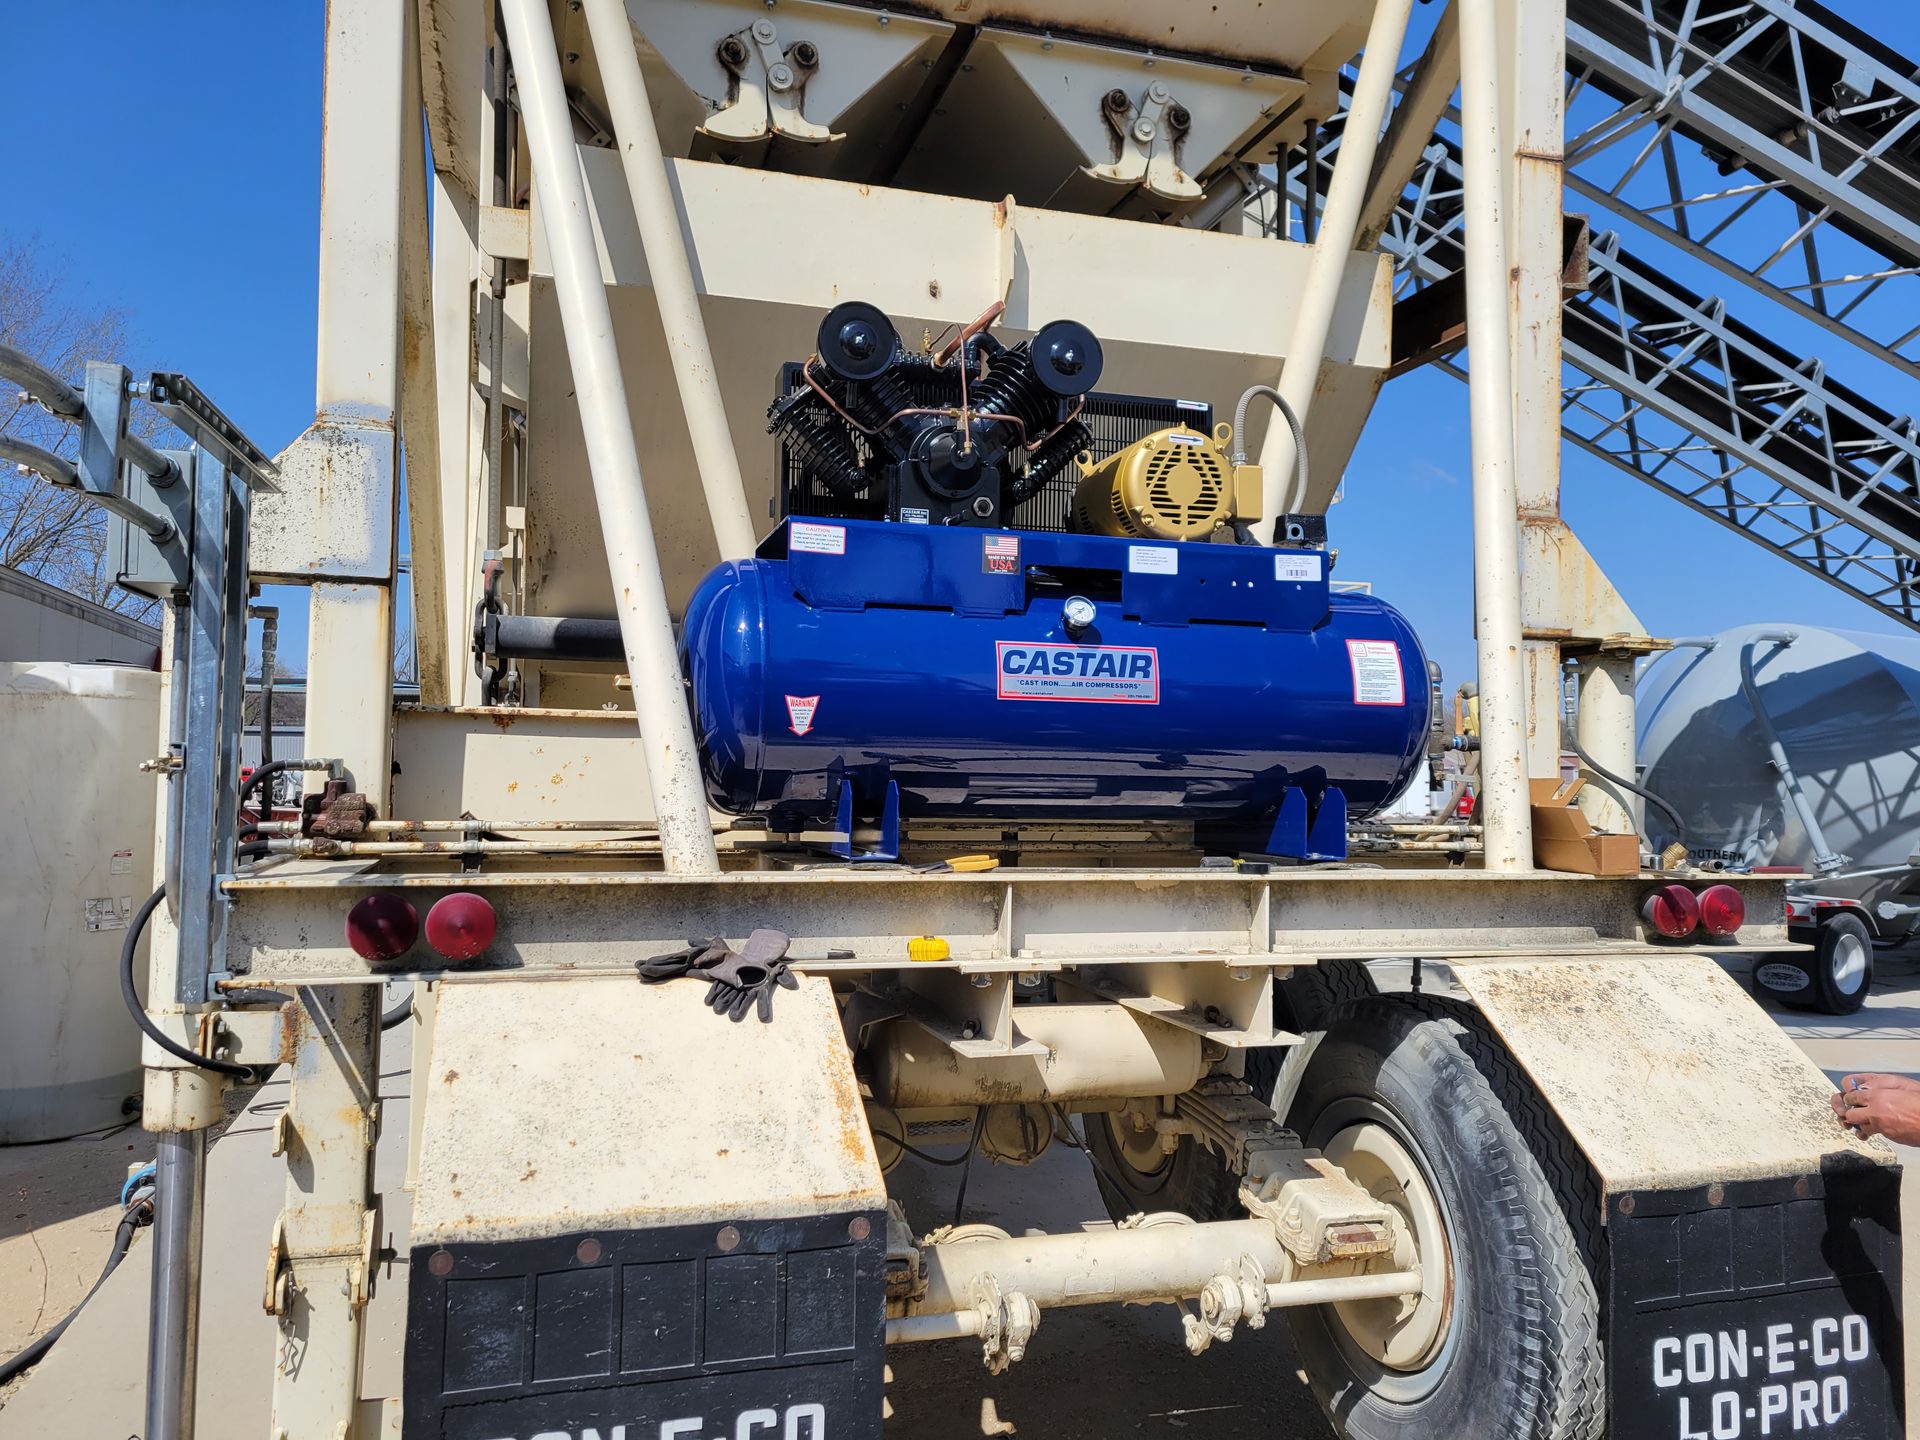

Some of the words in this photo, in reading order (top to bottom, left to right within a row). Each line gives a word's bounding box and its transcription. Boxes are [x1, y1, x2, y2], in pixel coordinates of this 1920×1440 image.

[989, 559, 1014, 570] USA
[1002, 649, 1153, 679] CASTAIR
[790, 698, 815, 708] WARNING
[1689, 848, 1745, 864] OUTHERN
